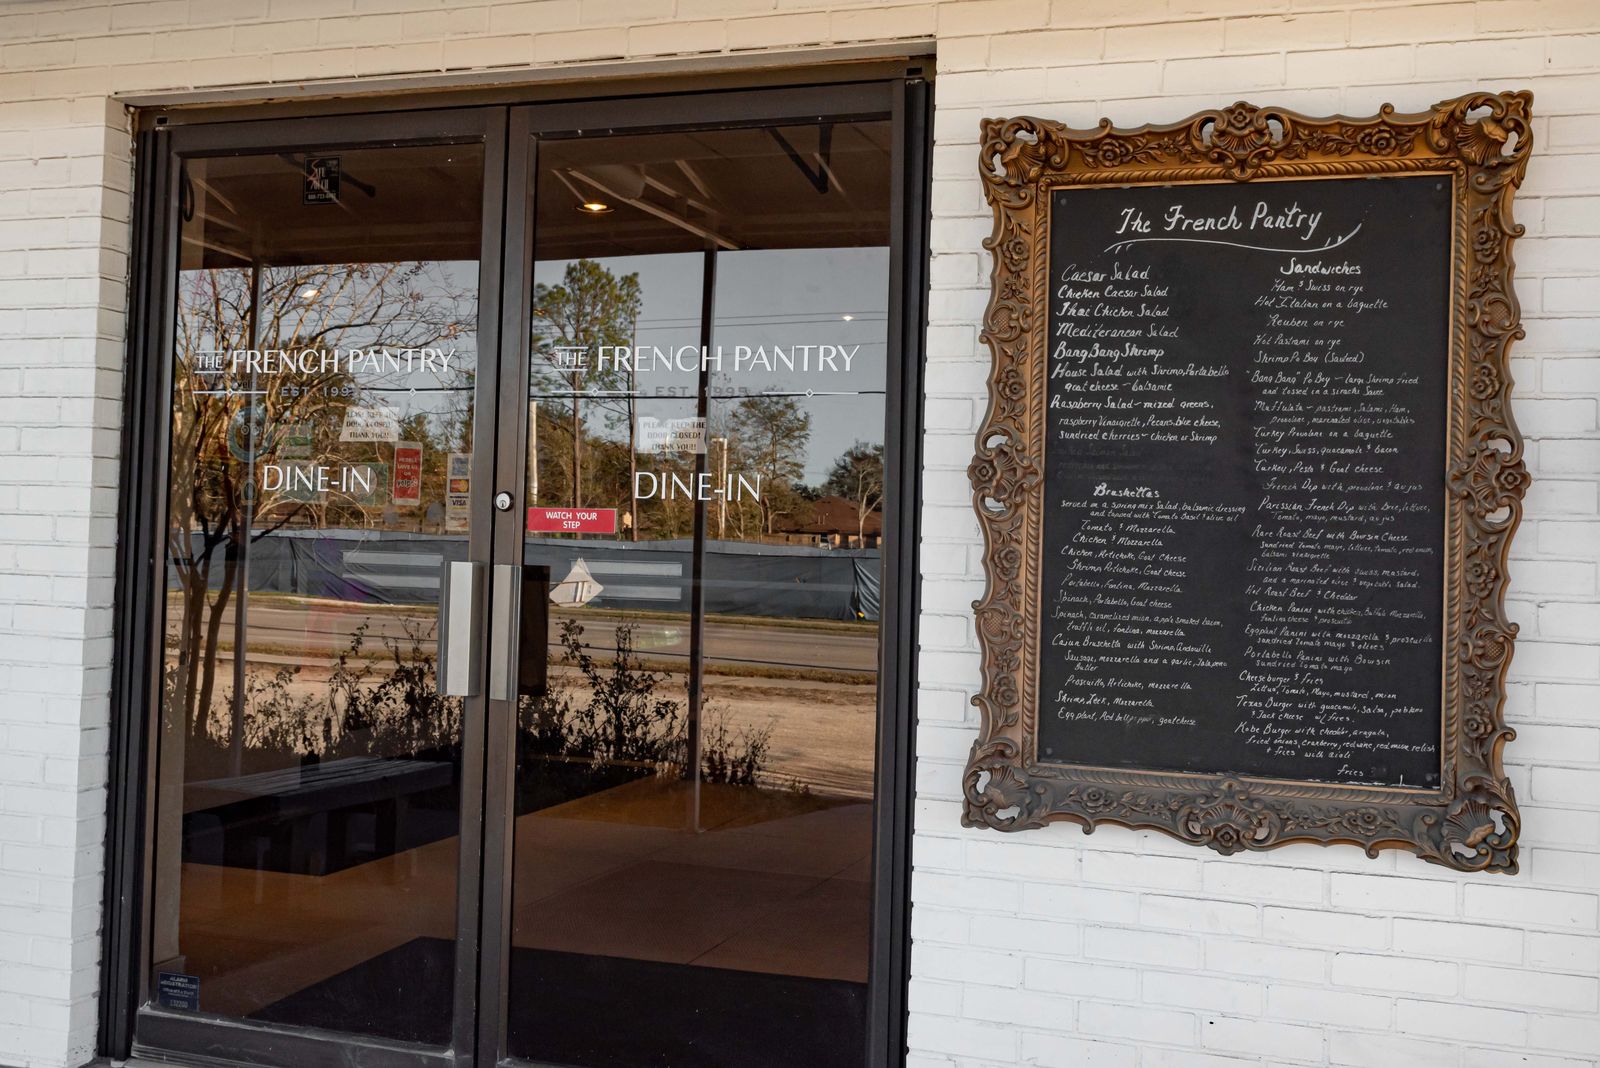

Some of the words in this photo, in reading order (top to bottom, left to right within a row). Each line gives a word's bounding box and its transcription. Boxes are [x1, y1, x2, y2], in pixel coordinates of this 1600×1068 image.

[1116, 208, 1151, 234] The
[1164, 204, 1242, 231] French
[1250, 201, 1322, 241] Pantry
[1061, 264, 1107, 282] Caesar
[1110, 262, 1150, 280] Salad
[1280, 257, 1362, 275] Sandwiches
[1058, 285, 1100, 299] Chicken
[1104, 285, 1138, 298] Caesar
[1141, 285, 1169, 297] Salad
[1271, 278, 1294, 292] Ham
[1305, 279, 1331, 291] Swiss
[1348, 286, 1364, 295] rye
[1254, 296, 1274, 307] Hot
[1056, 302, 1090, 317] Thai
[1094, 302, 1134, 317] Chicken
[1137, 303, 1169, 317] Salad
[1267, 314, 1308, 327] Reuben
[1328, 320, 1344, 328] rye
[1147, 323, 1179, 338] Salad
[1253, 334, 1270, 345] Hot
[1327, 339, 1341, 350] rye
[556, 352, 587, 365] THE
[598, 345, 722, 372] FRENCH
[735, 345, 860, 372] PANTRY
[1053, 341, 1088, 363] Bang
[1088, 343, 1120, 362] Bang
[1121, 342, 1165, 361] Shrimp
[196, 355, 223, 369] THE
[232, 349, 339, 374] FRENCH
[349, 349, 455, 373] PANTRY
[1051, 362, 1087, 379] House
[1091, 362, 1123, 376] Salad
[1127, 367, 1147, 376] with
[1090, 382, 1119, 391] cheese
[1314, 372, 1331, 387] Boy
[1262, 387, 1278, 395] and
[1051, 395, 1101, 410] Raspberry
[1104, 396, 1133, 409] Salad
[1059, 416, 1097, 427] raspberry
[263, 465, 371, 493] DINE-IN
[634, 472, 760, 501] DINE-IN
[546, 511, 572, 520] WATCH
[576, 512, 597, 520] YOUR
[563, 521, 580, 529] STEP
